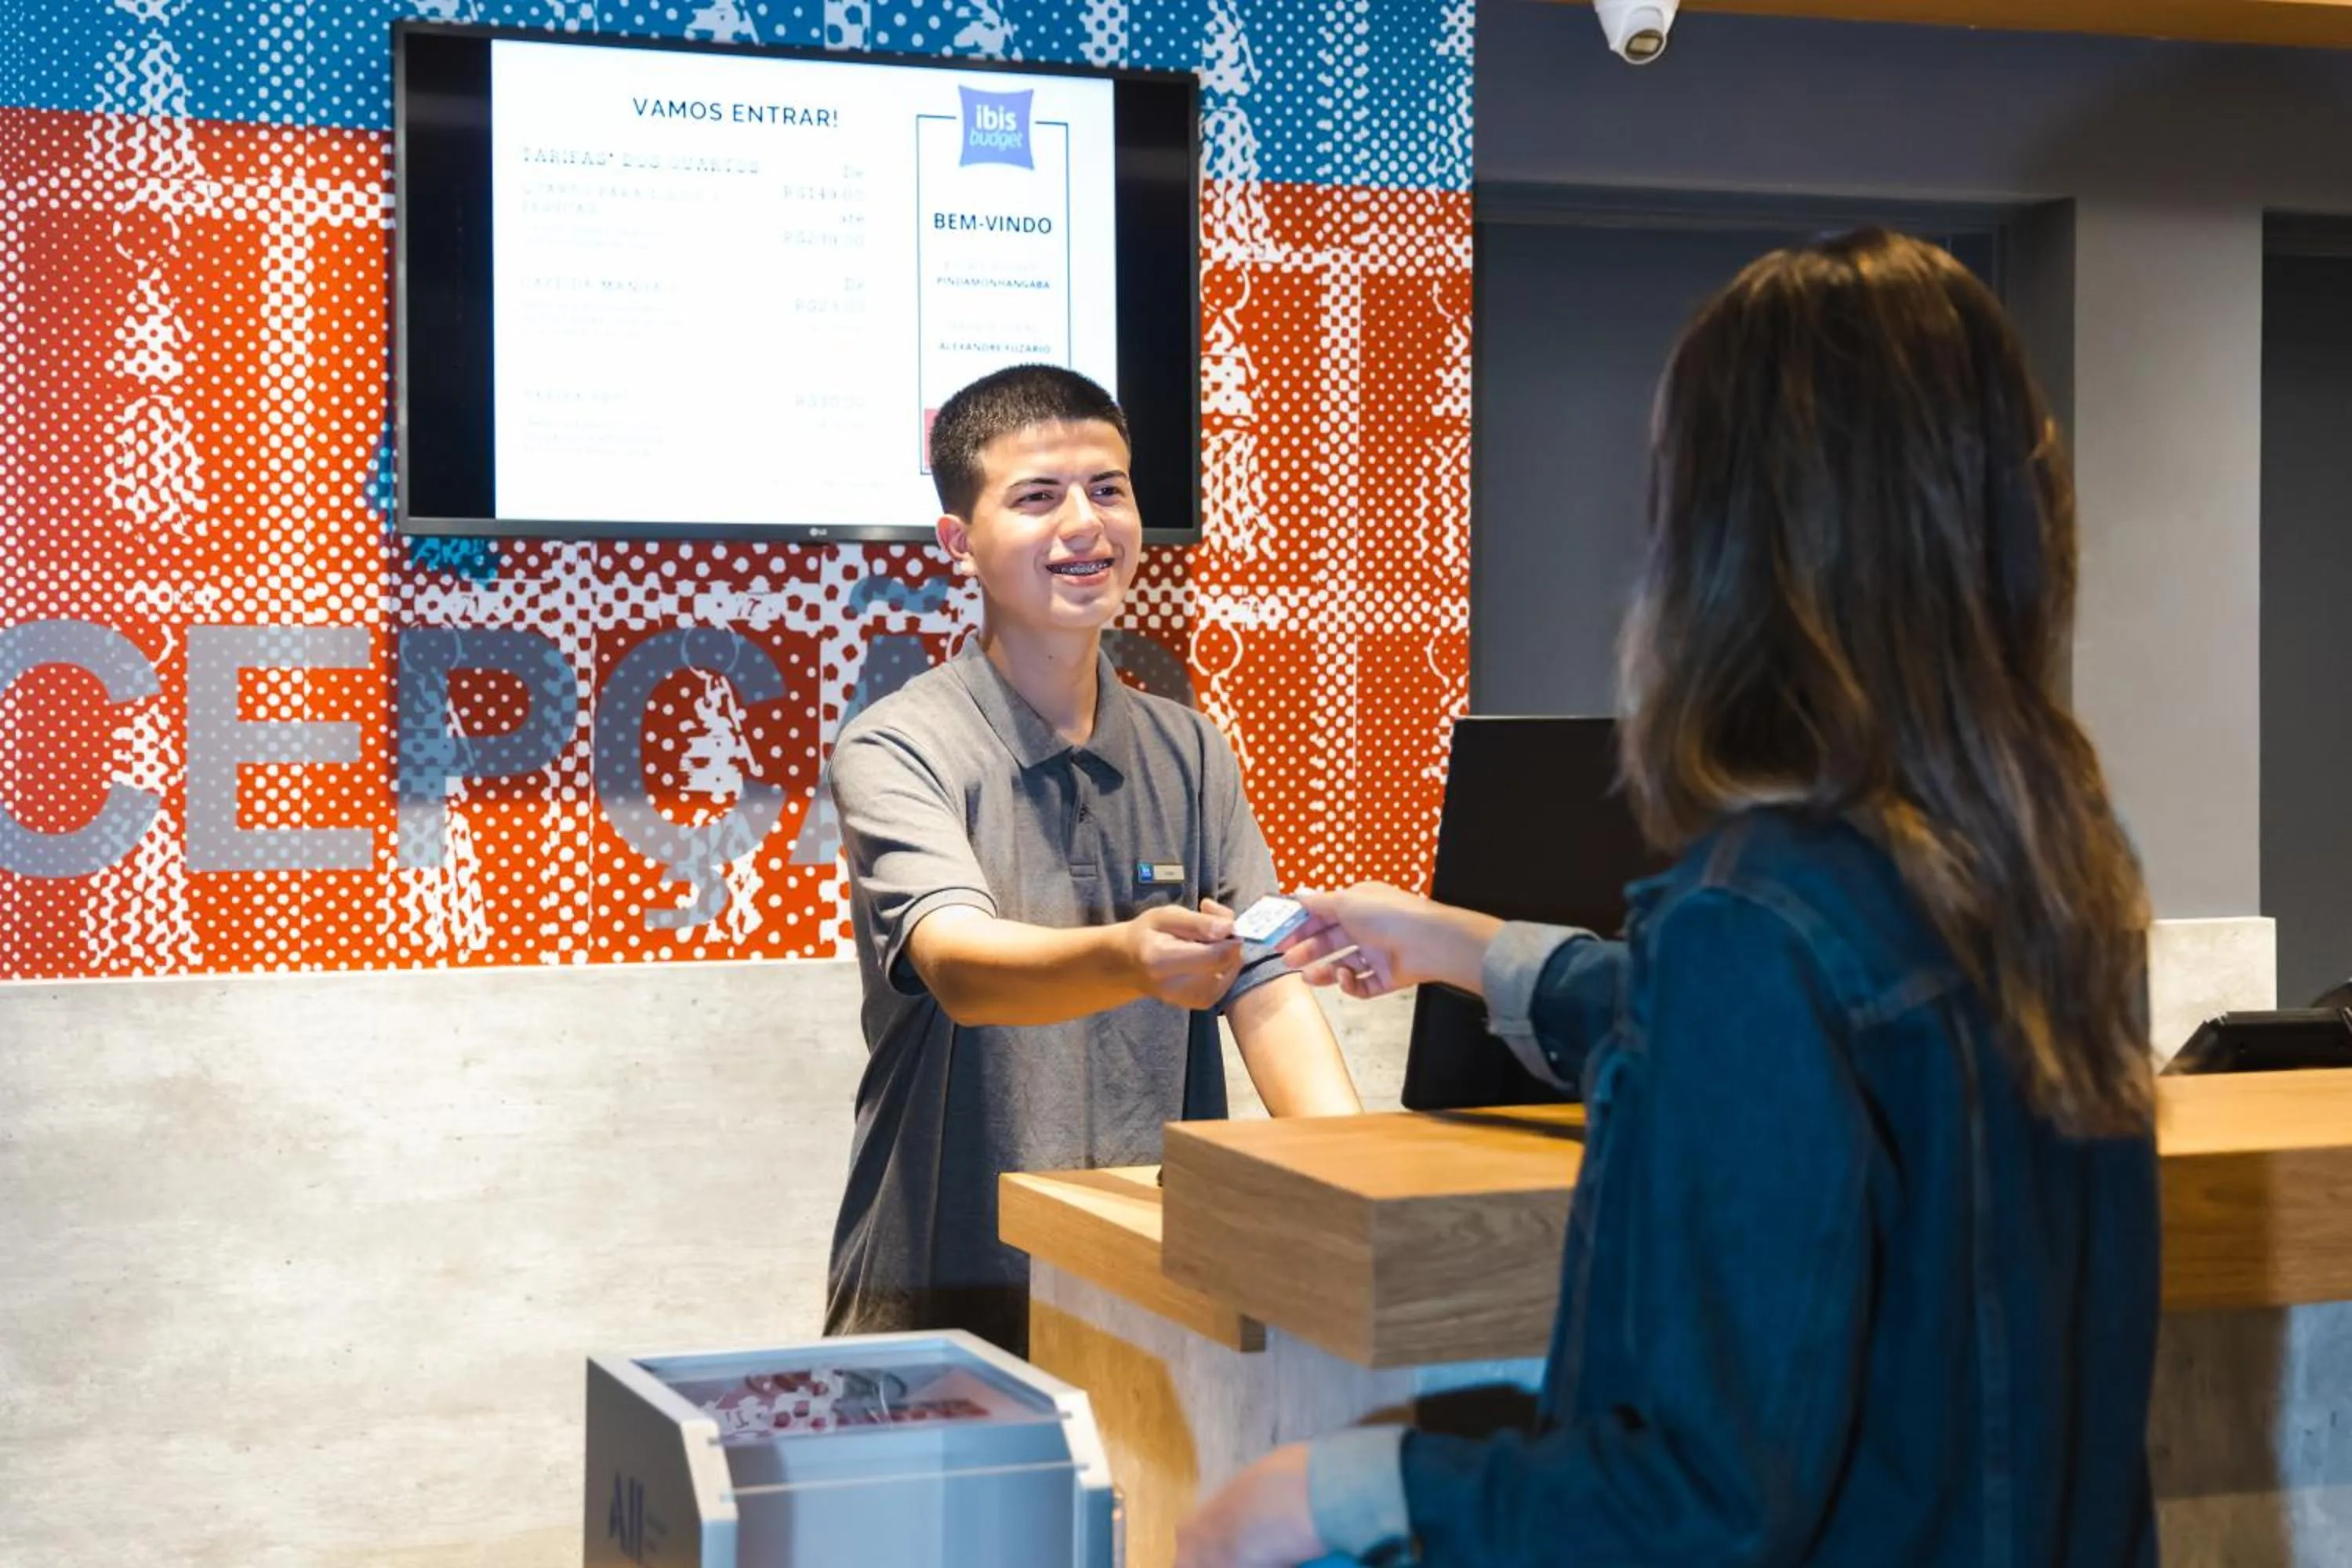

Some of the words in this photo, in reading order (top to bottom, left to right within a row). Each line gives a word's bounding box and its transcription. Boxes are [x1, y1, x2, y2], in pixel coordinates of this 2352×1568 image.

[633, 97, 722, 122] VAMOS
[732, 103, 839, 128] ENTRAR!
[975, 103, 1017, 131] ibis
[968, 126, 1024, 152] budget
[934, 212, 1052, 234] BEM-VINDO
[936, 276, 1051, 290] PINDAMONHANGABA
